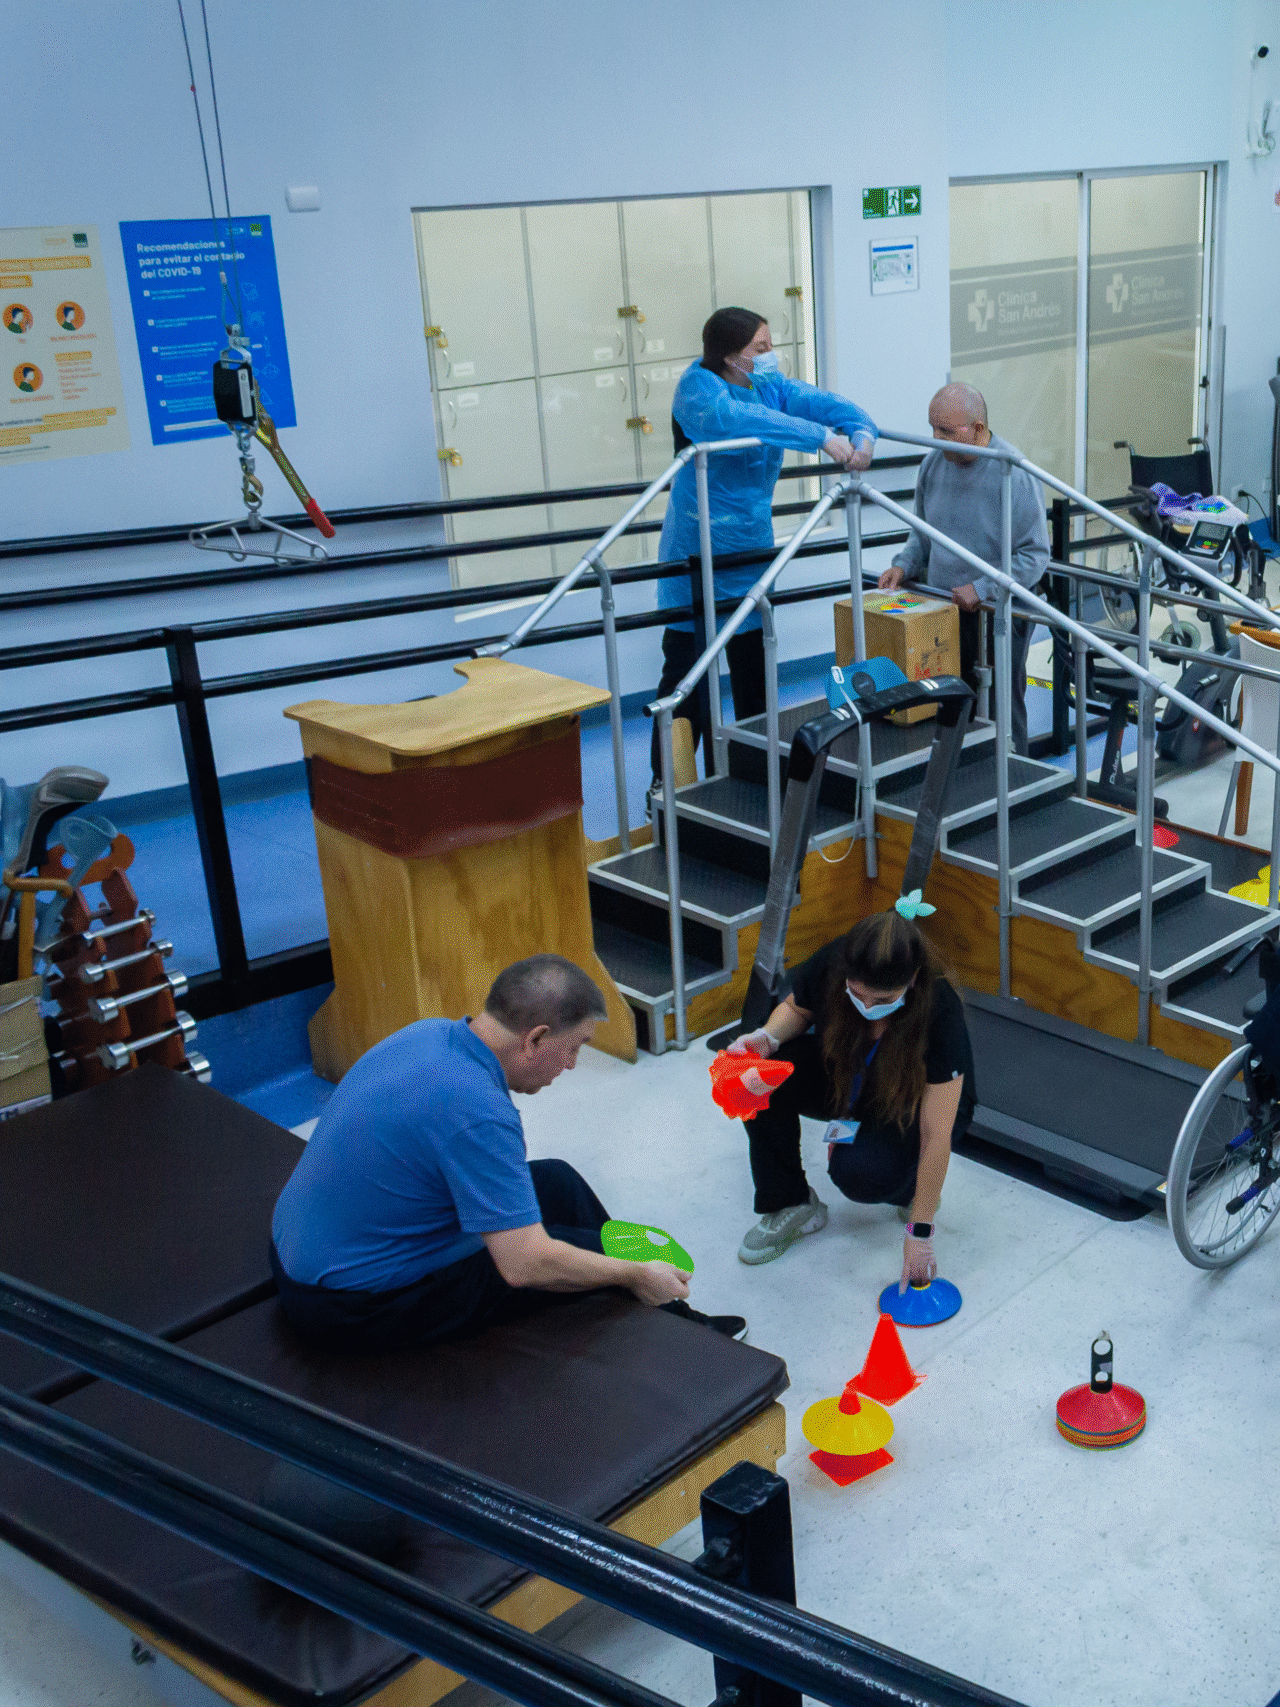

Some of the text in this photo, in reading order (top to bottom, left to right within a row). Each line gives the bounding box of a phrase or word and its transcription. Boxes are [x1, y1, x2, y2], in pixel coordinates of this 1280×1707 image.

[139, 257, 162, 268] para
[163, 254, 192, 264] evitar
[194, 253, 203, 262] el
[141, 266, 202, 279] del COVID-19
[998, 308, 1020, 323] San
